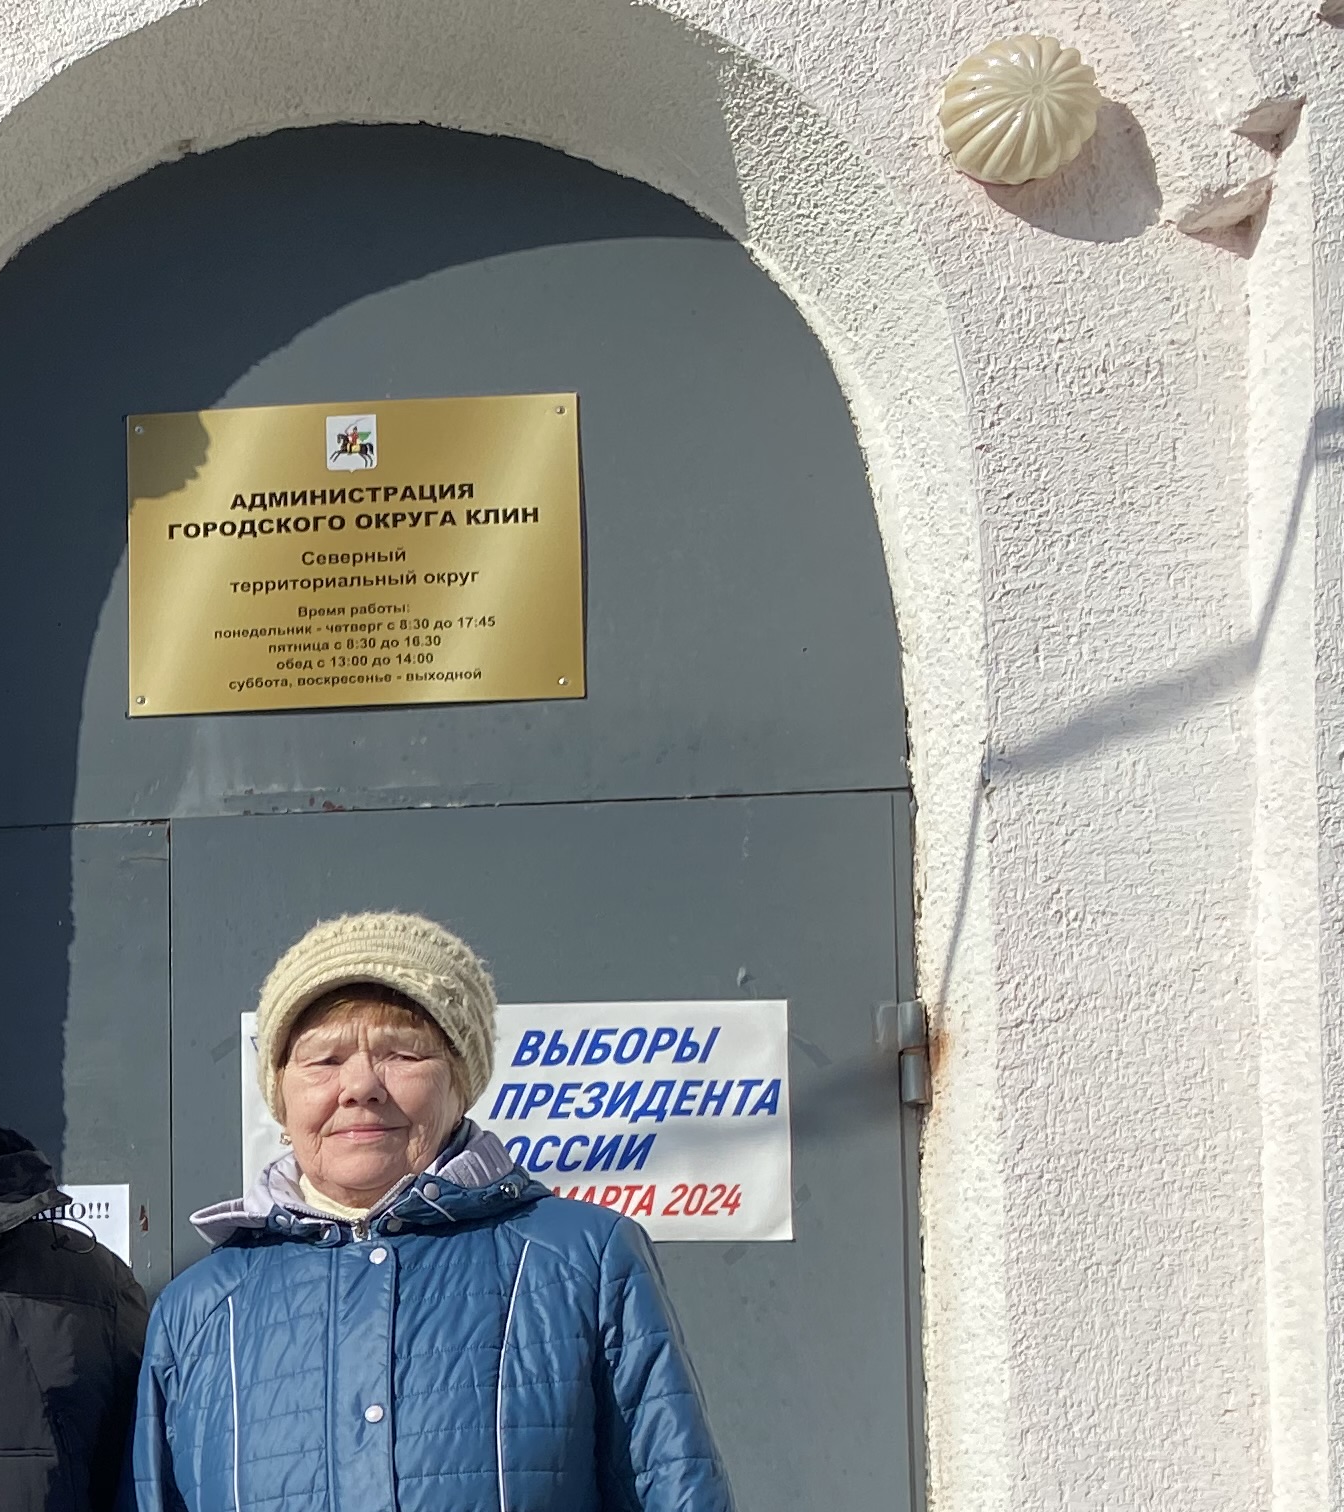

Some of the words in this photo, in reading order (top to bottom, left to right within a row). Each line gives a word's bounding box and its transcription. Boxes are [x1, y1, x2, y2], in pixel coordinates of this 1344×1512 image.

[230, 483, 474, 512] АДМИНИСТРАЦИЯ
[168, 514, 346, 540] ГОРОДСКОГО
[355, 510, 458, 530] ОКРУГА
[466, 507, 539, 526] КЛИН
[301, 547, 406, 567] Северный
[230, 570, 417, 595] территориальный
[423, 571, 480, 587] округ
[298, 605, 346, 620] Время
[350, 603, 411, 618] работы:
[214, 624, 312, 640] понедельник
[326, 621, 383, 635] четверг
[387, 622, 395, 631] с
[399, 618, 430, 631] 8:30
[433, 620, 453, 631] до
[457, 615, 496, 629] 17:45
[268, 641, 330, 654] пятница
[333, 642, 342, 651] с
[346, 638, 376, 650] 8:30
[380, 638, 400, 650] до
[276, 658, 314, 671] обед
[317, 659, 325, 669] с
[330, 655, 368, 668] 13:00
[371, 655, 391, 667] до
[395, 652, 434, 665] 14:00
[228, 677, 293, 693] суббота,
[297, 673, 392, 688] воскресенье
[406, 668, 482, 682] выходной
[510, 1026, 721, 1067] ВЫБОРЫ
[488, 1078, 782, 1124] ПРЕЗИДЕНТА
[503, 1133, 658, 1173] ОССИИ
[661, 1183, 742, 1217] 2024
